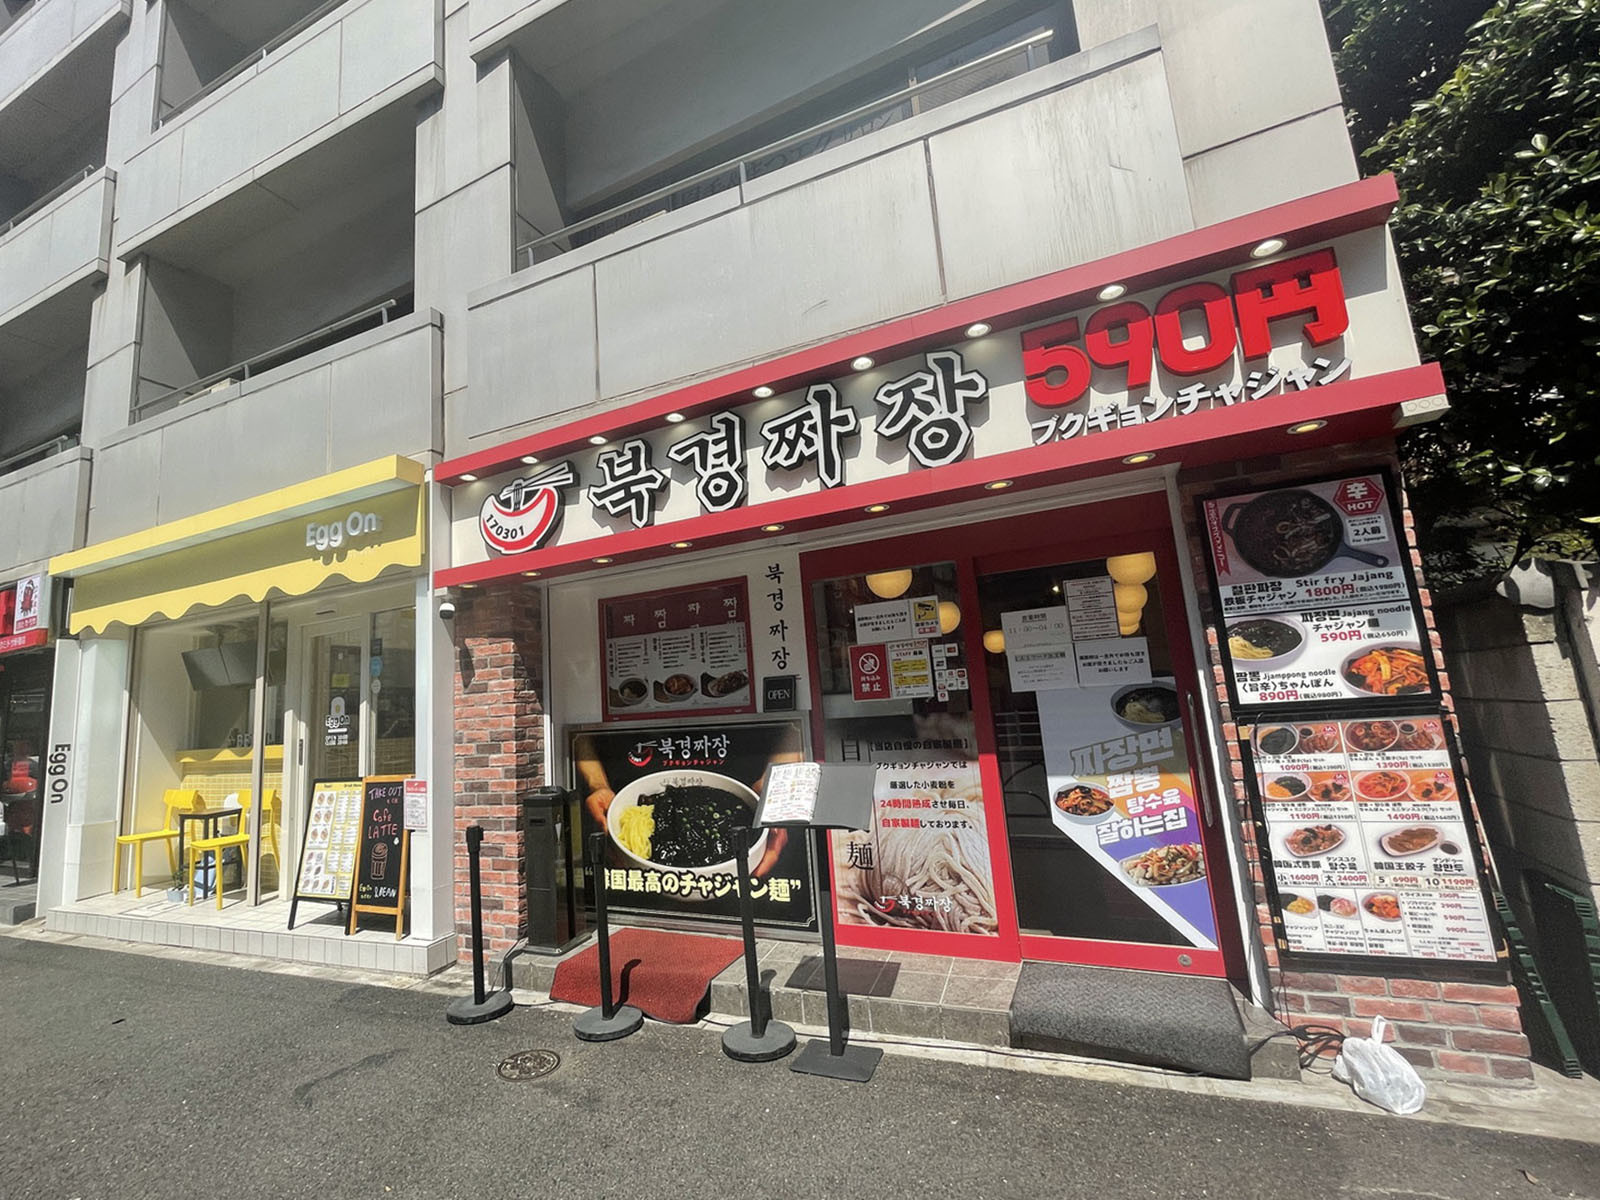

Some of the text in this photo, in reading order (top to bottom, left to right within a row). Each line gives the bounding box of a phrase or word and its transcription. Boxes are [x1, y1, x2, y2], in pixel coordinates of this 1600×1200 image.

[1020, 246, 1350, 410] 590円
[1031, 356, 1352, 447] ブクギョンチャジャン
[586, 349, 989, 529] 북경짜장
[1346, 482, 1368, 500] 辛
[1347, 500, 1374, 511] HOT
[306, 511, 378, 551] Egg On
[485, 513, 526, 540] 170301
[1296, 570, 1394, 588] Stir fry Jajang
[1305, 583, 1355, 598] 1800円
[765, 563, 791, 670] 북경짜장
[1341, 604, 1411, 618] Jajang noodle
[1320, 629, 1362, 643] 590円
[1308, 668, 1337, 678] noodle
[767, 689, 792, 700] OPEN
[861, 682, 882, 693] 禁止
[1259, 689, 1299, 702] 890円
[657, 734, 731, 759] 북경짜장
[48, 743, 71, 804] Egg On
[1376, 761, 1409, 769] 1390円
[1106, 764, 1160, 799] 짬뽕
[368, 787, 387, 801] TAKE
[387, 786, 403, 797] OUT
[1126, 788, 1182, 815] 탕수육
[1289, 812, 1320, 820] 1190円
[1387, 813, 1421, 821] 1490円
[367, 823, 398, 840] LATTE
[1096, 806, 1188, 846] 잘하는집
[1277, 873, 1287, 882] 小
[1324, 874, 1334, 883] 大
[1378, 876, 1386, 884] 5
[1392, 876, 1419, 884] 690円
[1425, 878, 1440, 886] 10
[1441, 878, 1475, 886] 1190円
[896, 894, 953, 913] 북경짜장
